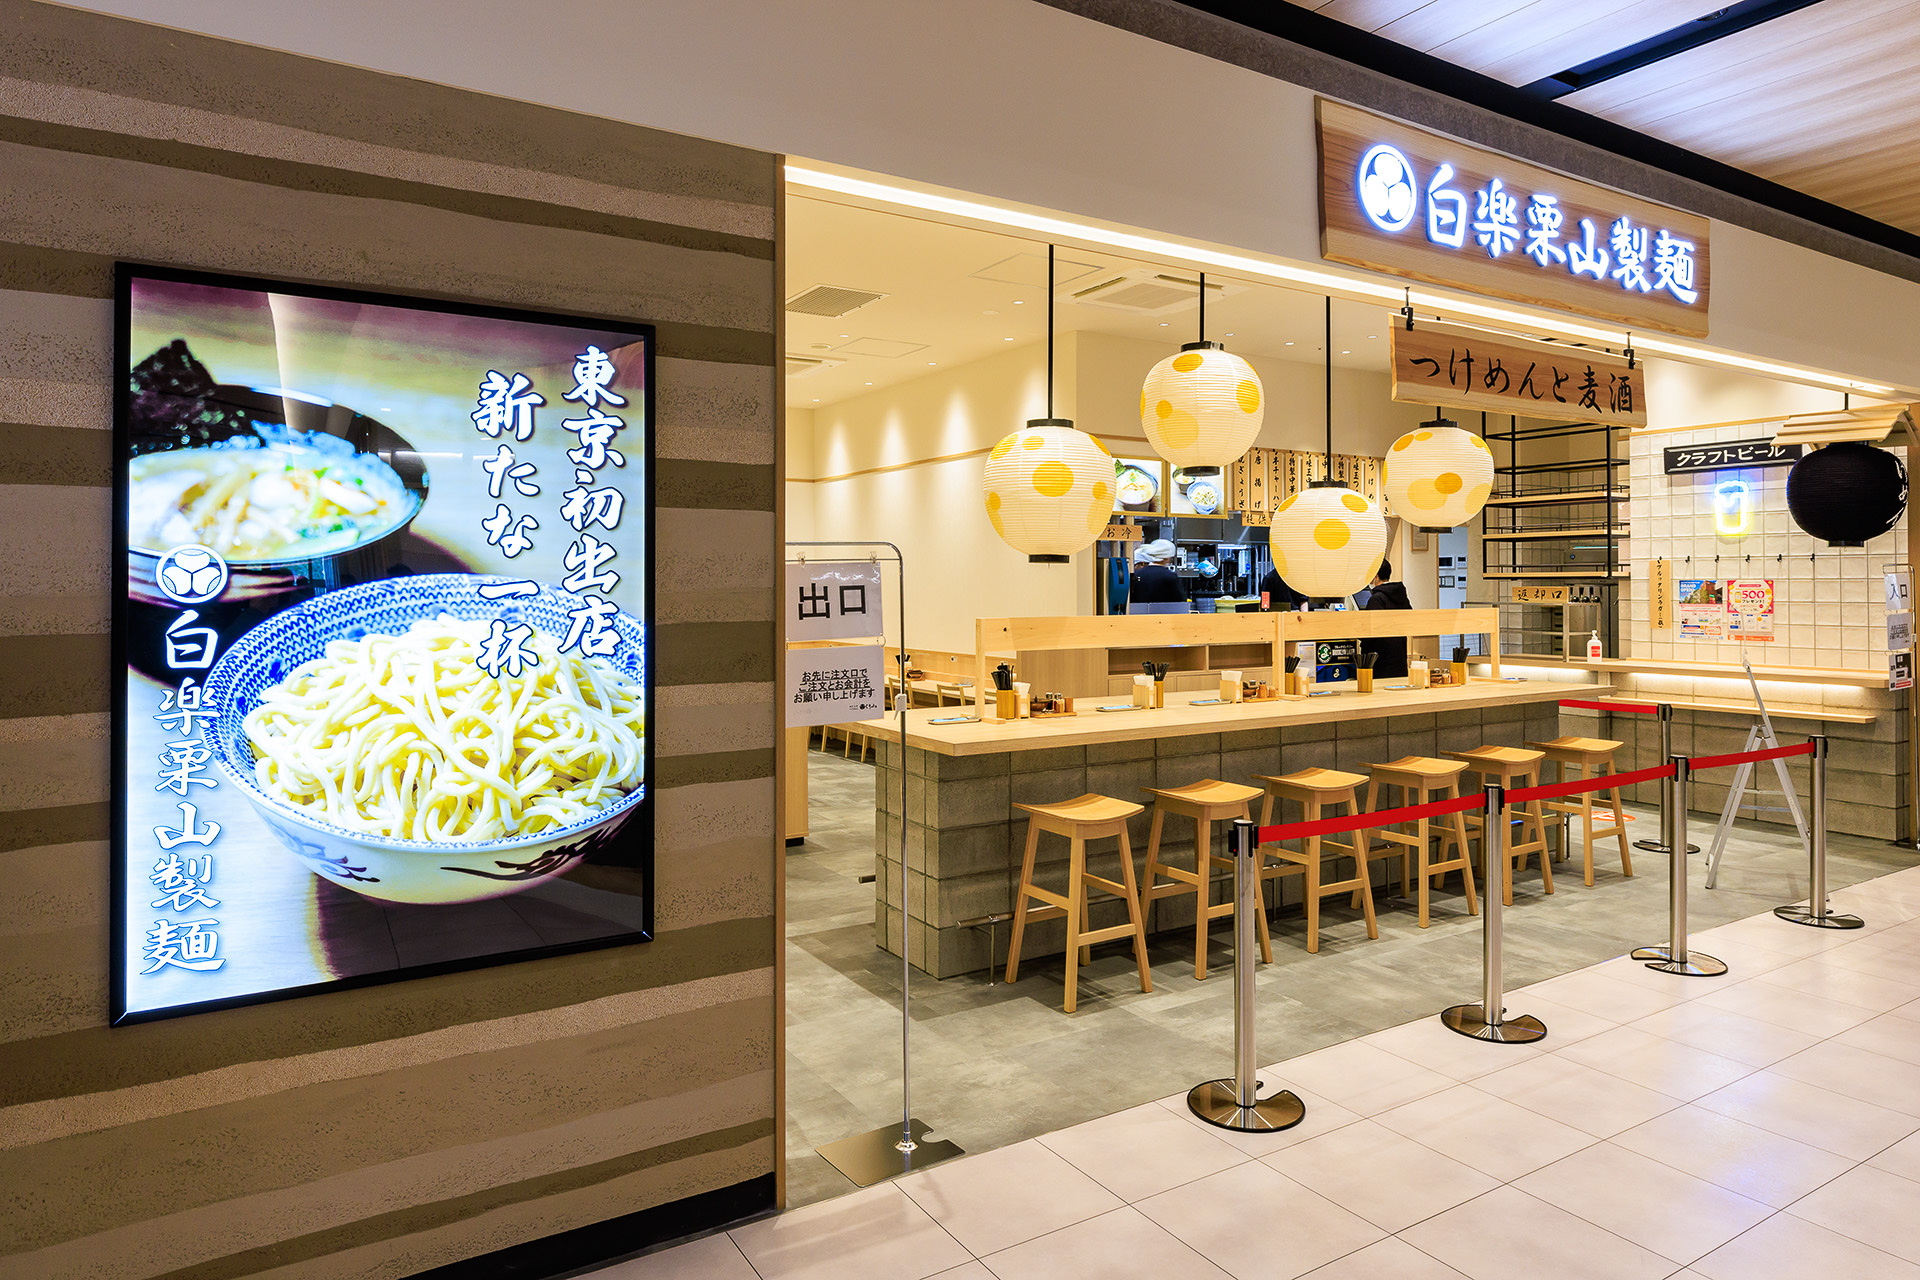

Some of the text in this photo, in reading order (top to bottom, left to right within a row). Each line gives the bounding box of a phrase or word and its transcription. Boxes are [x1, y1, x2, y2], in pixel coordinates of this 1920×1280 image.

[1425, 163, 1698, 304] 白楽栗山製麺
[1410, 348, 1634, 414] つけめんと麦酒
[1676, 446, 1786, 467] クラフトビール
[558, 345, 626, 659] 東京初出店
[471, 370, 544, 681] 新たな一杯
[798, 582, 867, 621] 出口
[1518, 588, 1563, 601] 返却口
[1741, 590, 1765, 599] 500
[1890, 583, 1908, 600] 入口
[798, 678, 871, 693] ご注文とお会計を
[802, 668, 868, 682] お先に注文口で
[793, 688, 875, 704] お願い申し上げます
[139, 608, 227, 976] 白楽栗山製麺
